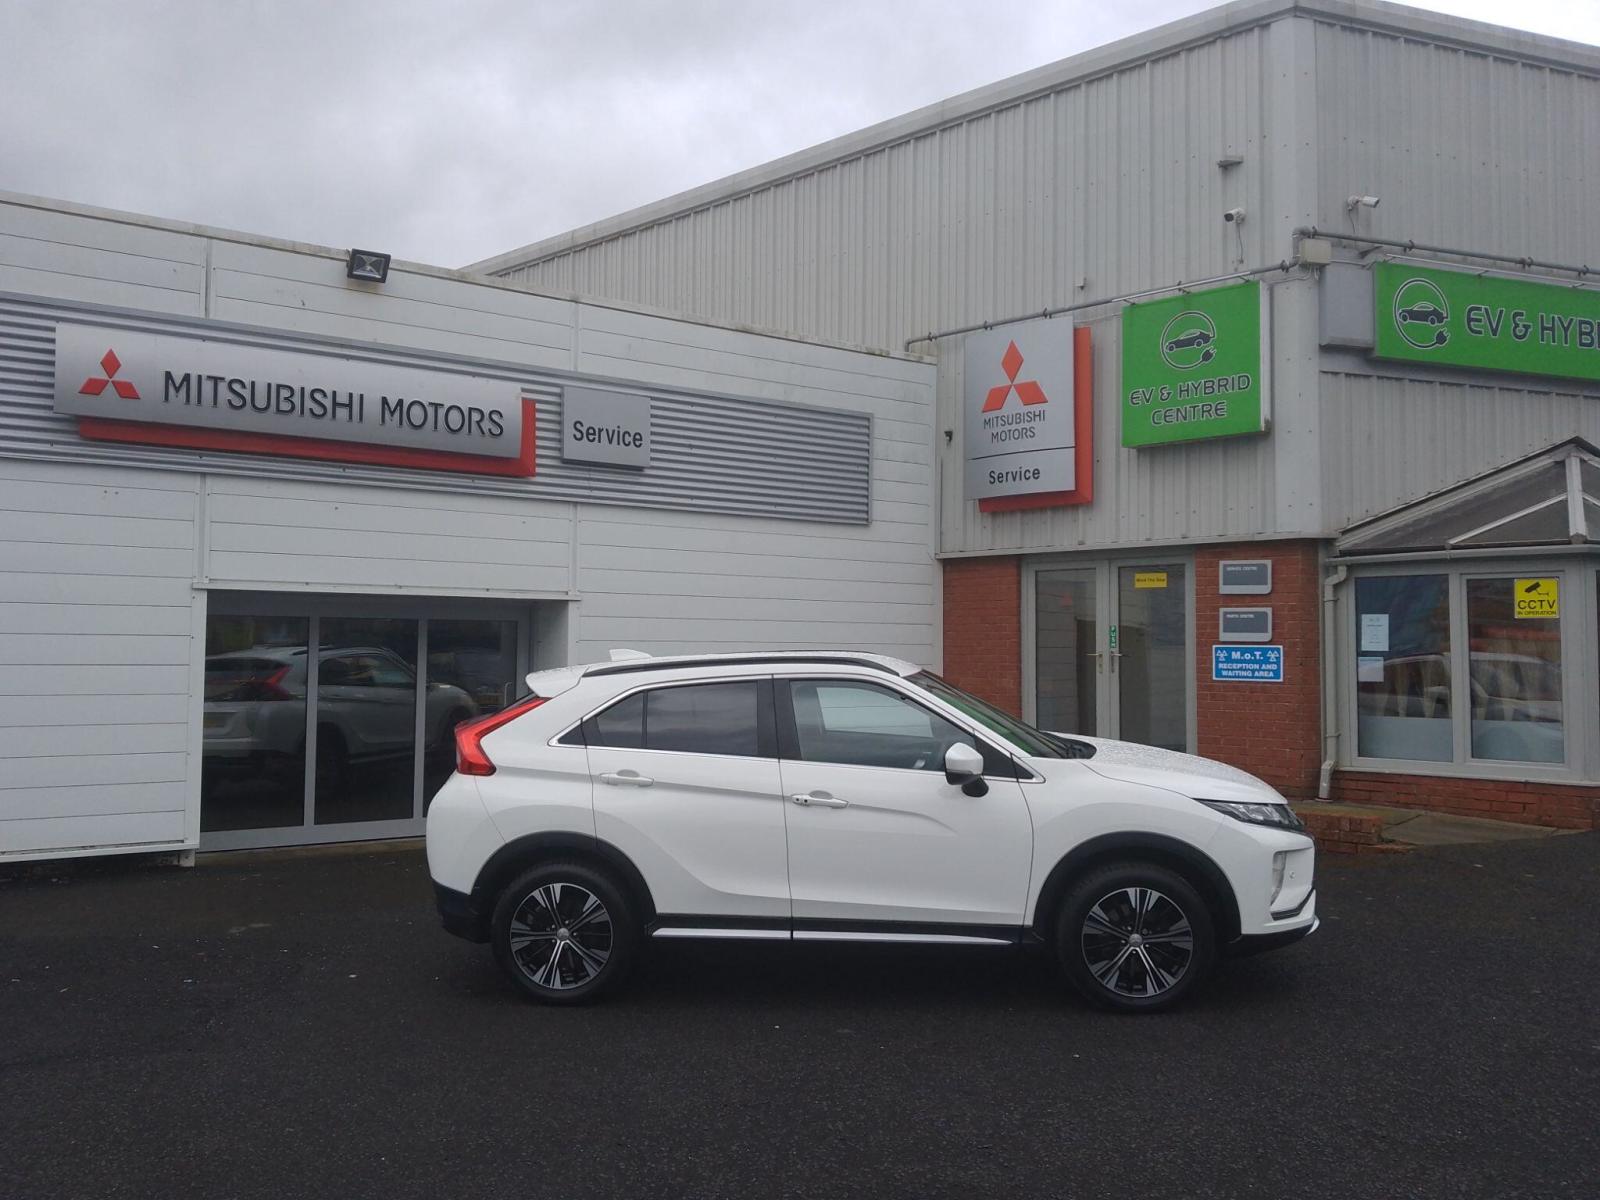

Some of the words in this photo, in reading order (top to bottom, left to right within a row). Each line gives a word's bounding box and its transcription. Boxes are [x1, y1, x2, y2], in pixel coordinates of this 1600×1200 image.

[1465, 304, 1505, 338] EV
[1511, 310, 1532, 341] &
[1539, 311, 1600, 351] HYB
[1130, 387, 1155, 406] EV
[1159, 385, 1172, 402] &
[1178, 373, 1251, 399] HYBRID
[163, 370, 365, 423] MITSUBISHI
[379, 395, 505, 438] MOTORS
[1152, 401, 1227, 426] CENTRE
[983, 409, 1046, 430] MITSUBISHI
[573, 420, 643, 448] Service
[991, 426, 1036, 444] MOTORS
[988, 466, 1041, 485] Service
[1517, 600, 1555, 609] CCTV
[1231, 651, 1264, 660] M.o.T.
